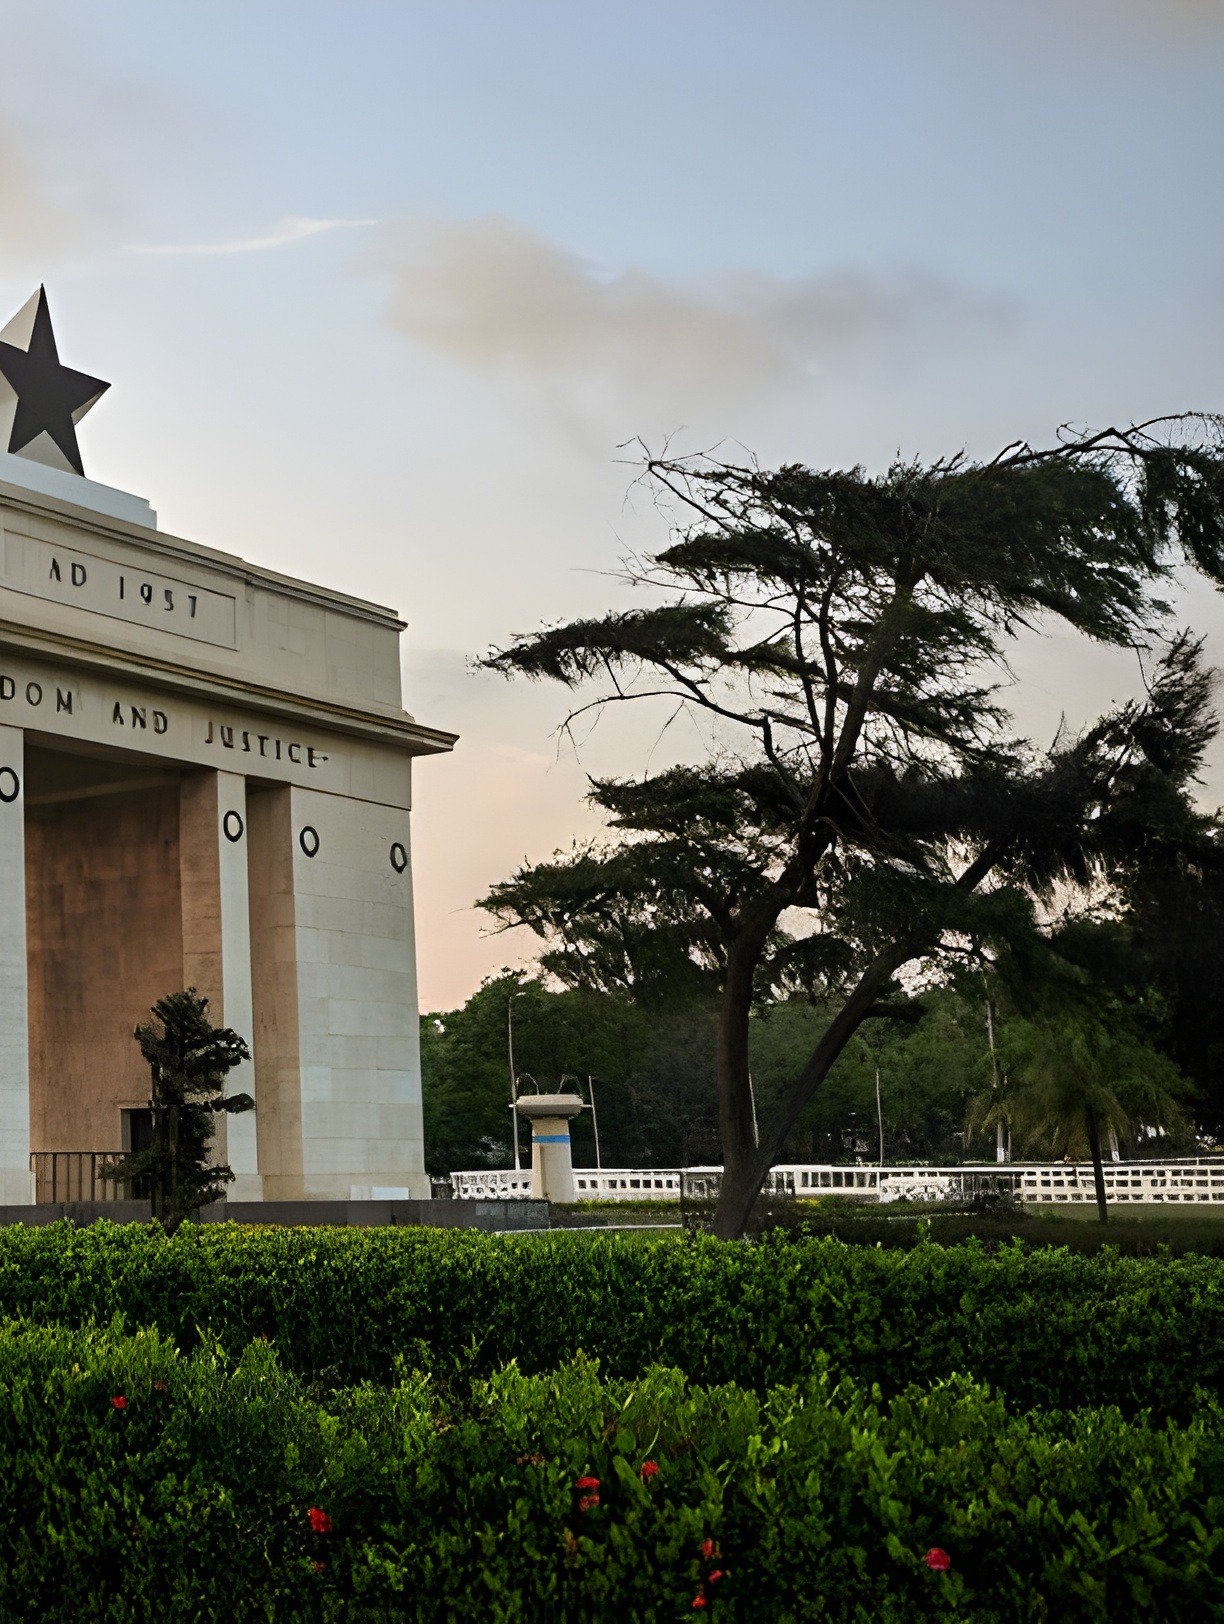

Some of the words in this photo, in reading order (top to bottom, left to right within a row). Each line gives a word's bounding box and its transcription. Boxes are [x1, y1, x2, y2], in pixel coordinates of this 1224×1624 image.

[49, 557, 87, 587] AD
[119, 575, 198, 618] 1957
[112, 701, 168, 735] AND
[204, 720, 318, 768] JUSTICE
